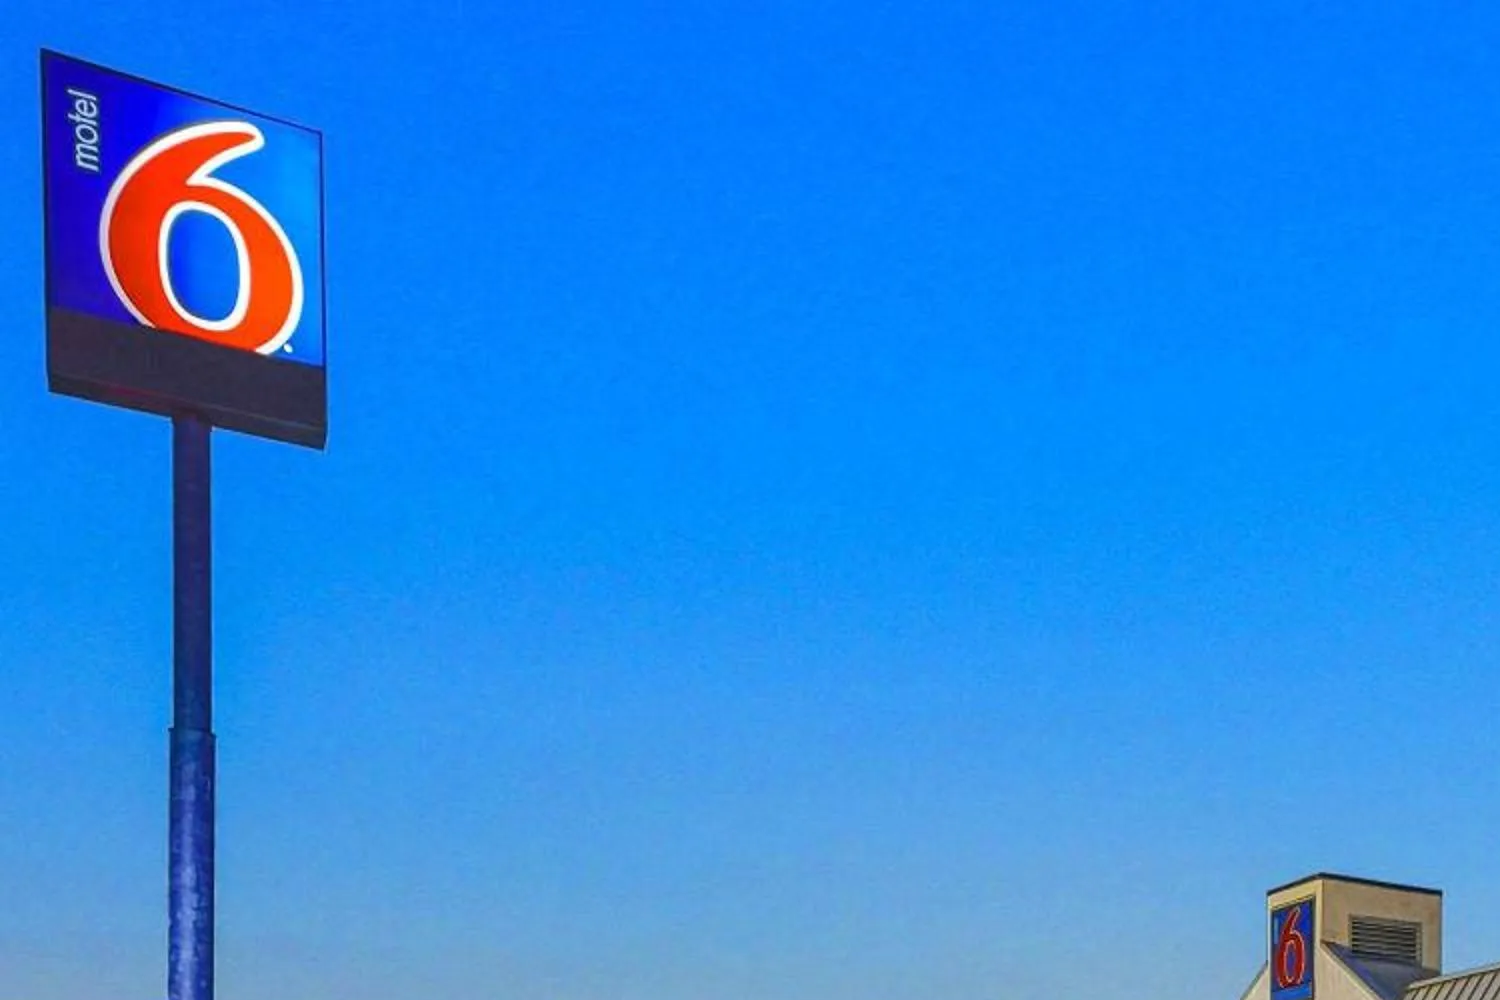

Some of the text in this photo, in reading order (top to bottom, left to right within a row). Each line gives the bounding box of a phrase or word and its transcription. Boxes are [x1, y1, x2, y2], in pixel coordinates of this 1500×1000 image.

[67, 88, 99, 172] motel
[99, 120, 304, 356] 6
[1276, 905, 1305, 989] 6
